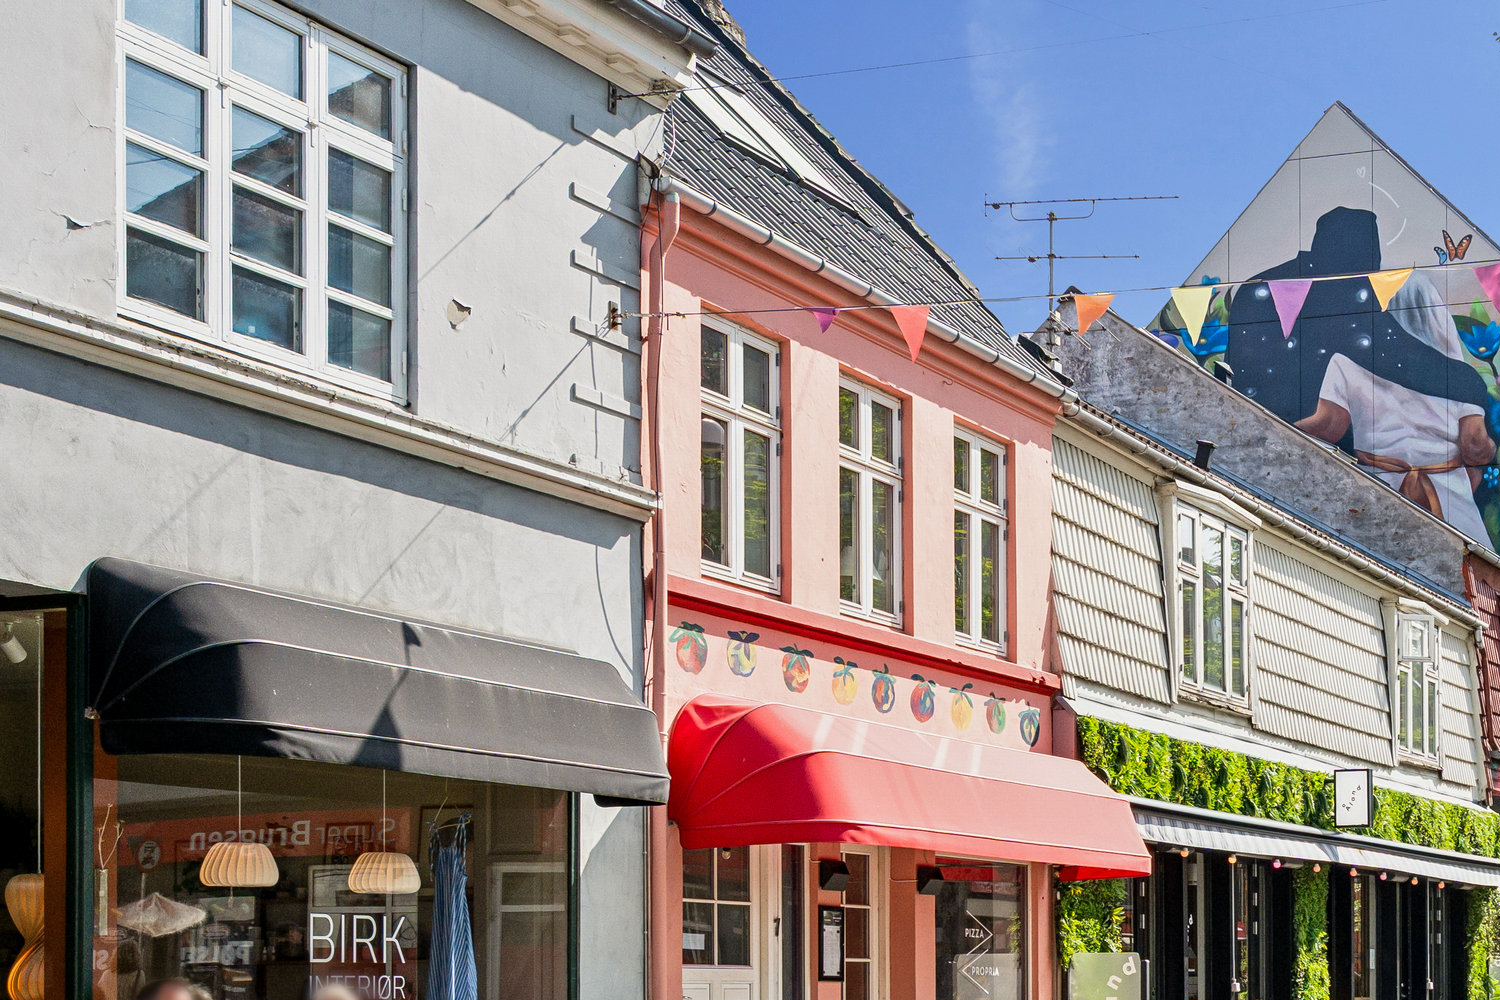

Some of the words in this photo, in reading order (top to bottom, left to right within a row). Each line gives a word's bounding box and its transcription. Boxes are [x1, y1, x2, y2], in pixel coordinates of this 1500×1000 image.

[309, 913, 406, 963] BIRK
[965, 928, 984, 938] PIZZA
[971, 966, 999, 976] PROPRIA
